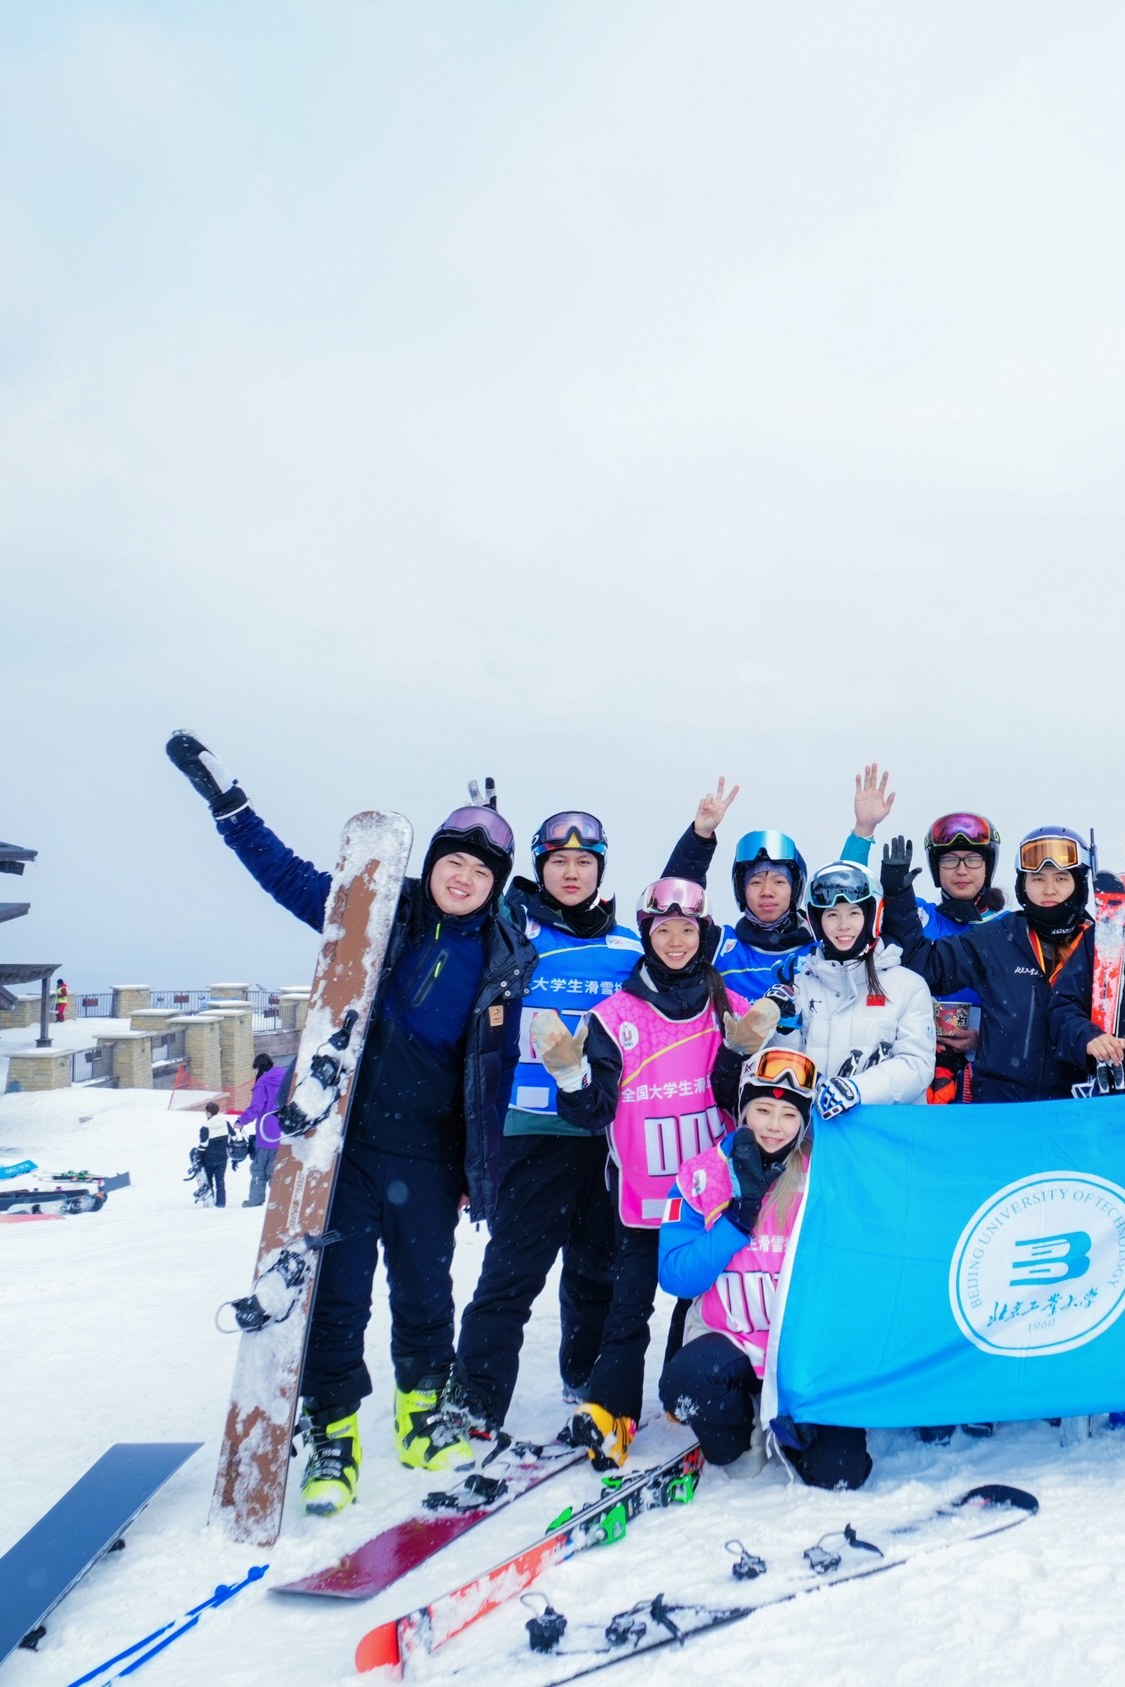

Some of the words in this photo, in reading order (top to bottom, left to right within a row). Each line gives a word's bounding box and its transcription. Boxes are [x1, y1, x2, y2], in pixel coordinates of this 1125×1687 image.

[967, 1248, 985, 1309] BEIJING
[978, 1188, 1068, 1244] UNIVERSITY
[1072, 1189, 1094, 1203] OF
[1027, 1318, 1056, 1333] 1960
